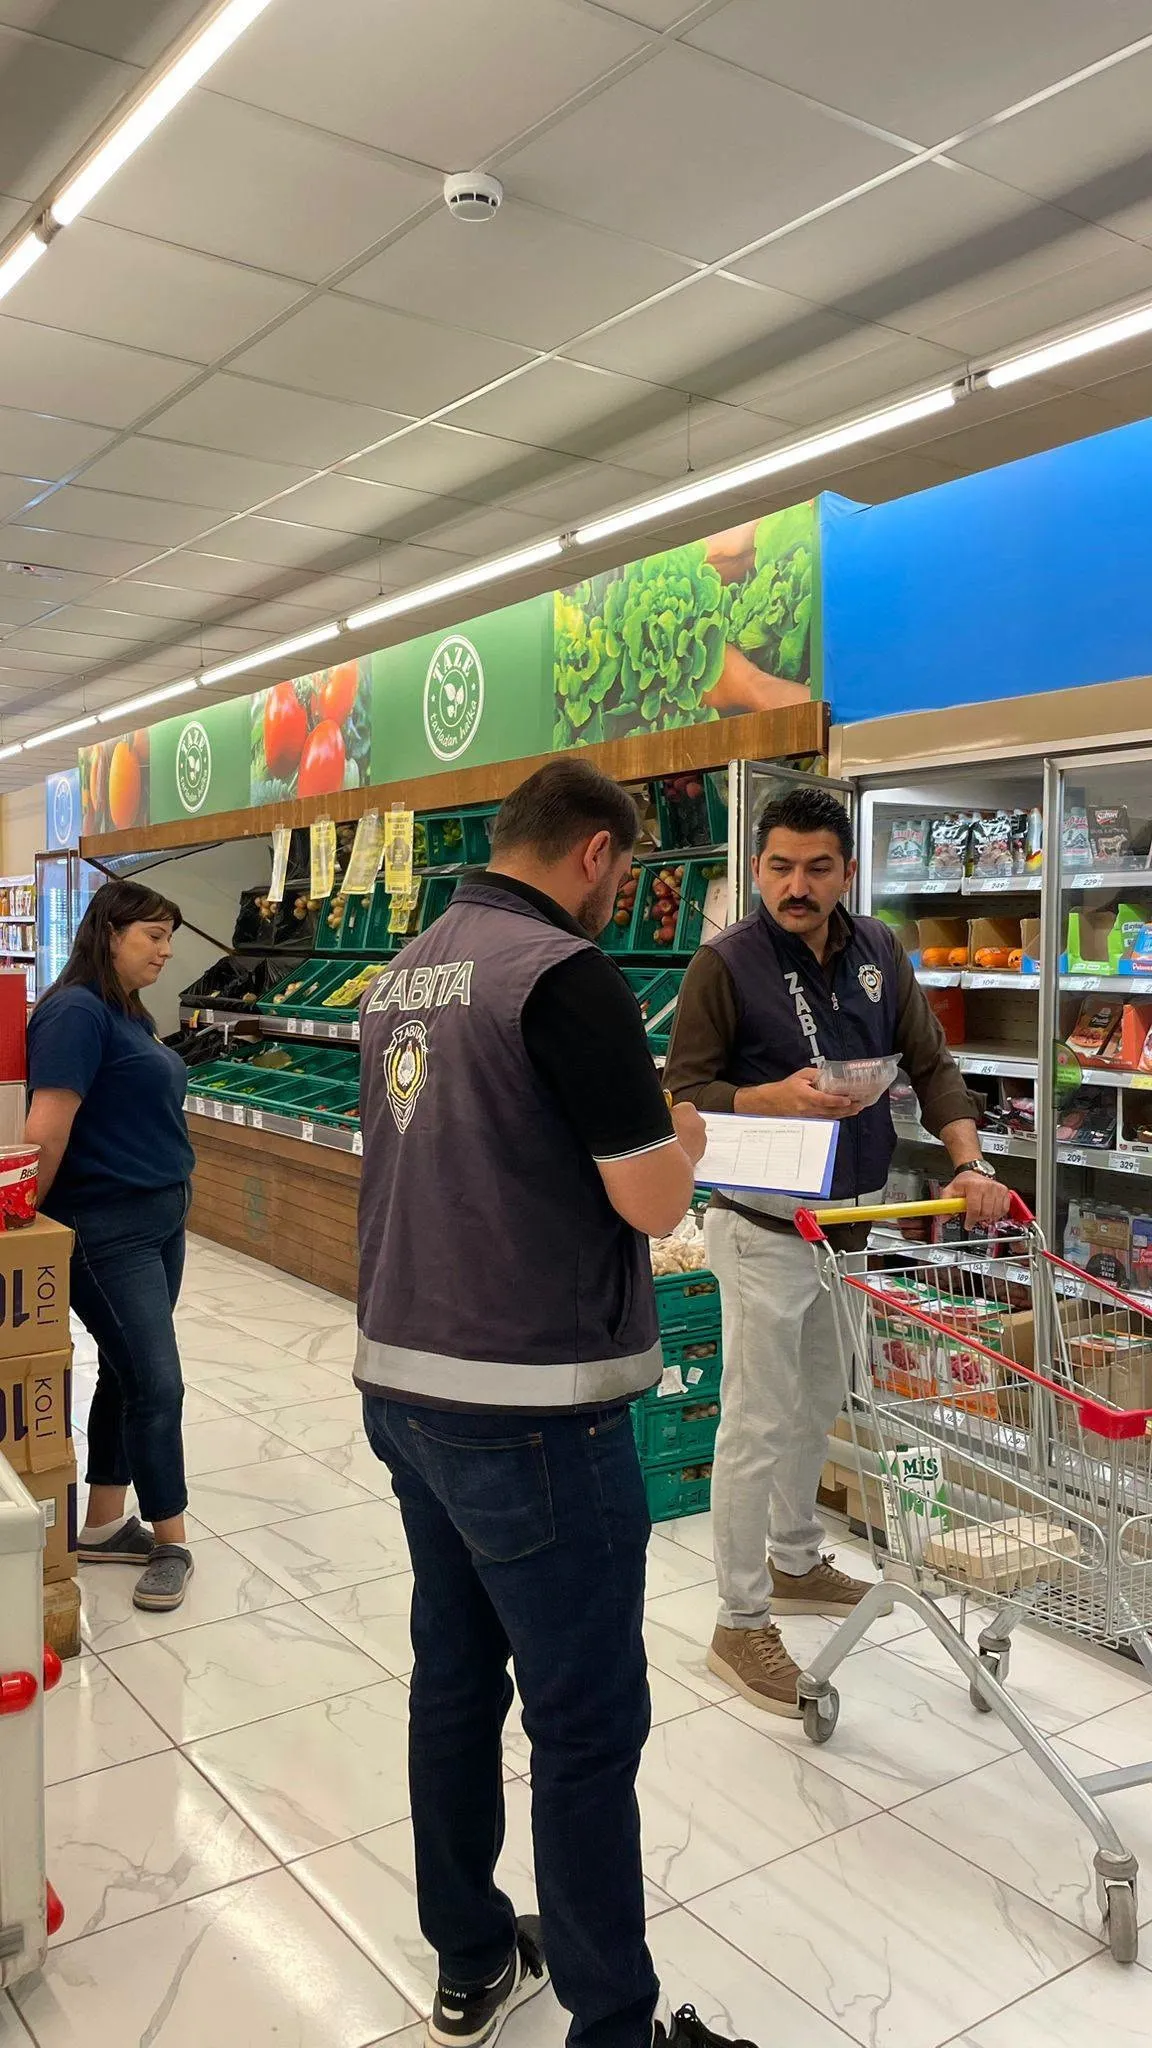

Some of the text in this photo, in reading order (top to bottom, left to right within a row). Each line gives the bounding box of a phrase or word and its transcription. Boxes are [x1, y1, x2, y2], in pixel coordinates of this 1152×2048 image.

[432, 646, 475, 684] TAZE
[430, 700, 478, 748] tarladan halka
[366, 961, 475, 1014] ZABITA
[784, 971, 826, 1067] ZABIT
[1067, 1153, 1082, 1163] 209
[1119, 1160, 1134, 1170] 329
[37, 1265, 58, 1325] KOLİ
[35, 1377, 56, 1438] KOLİ
